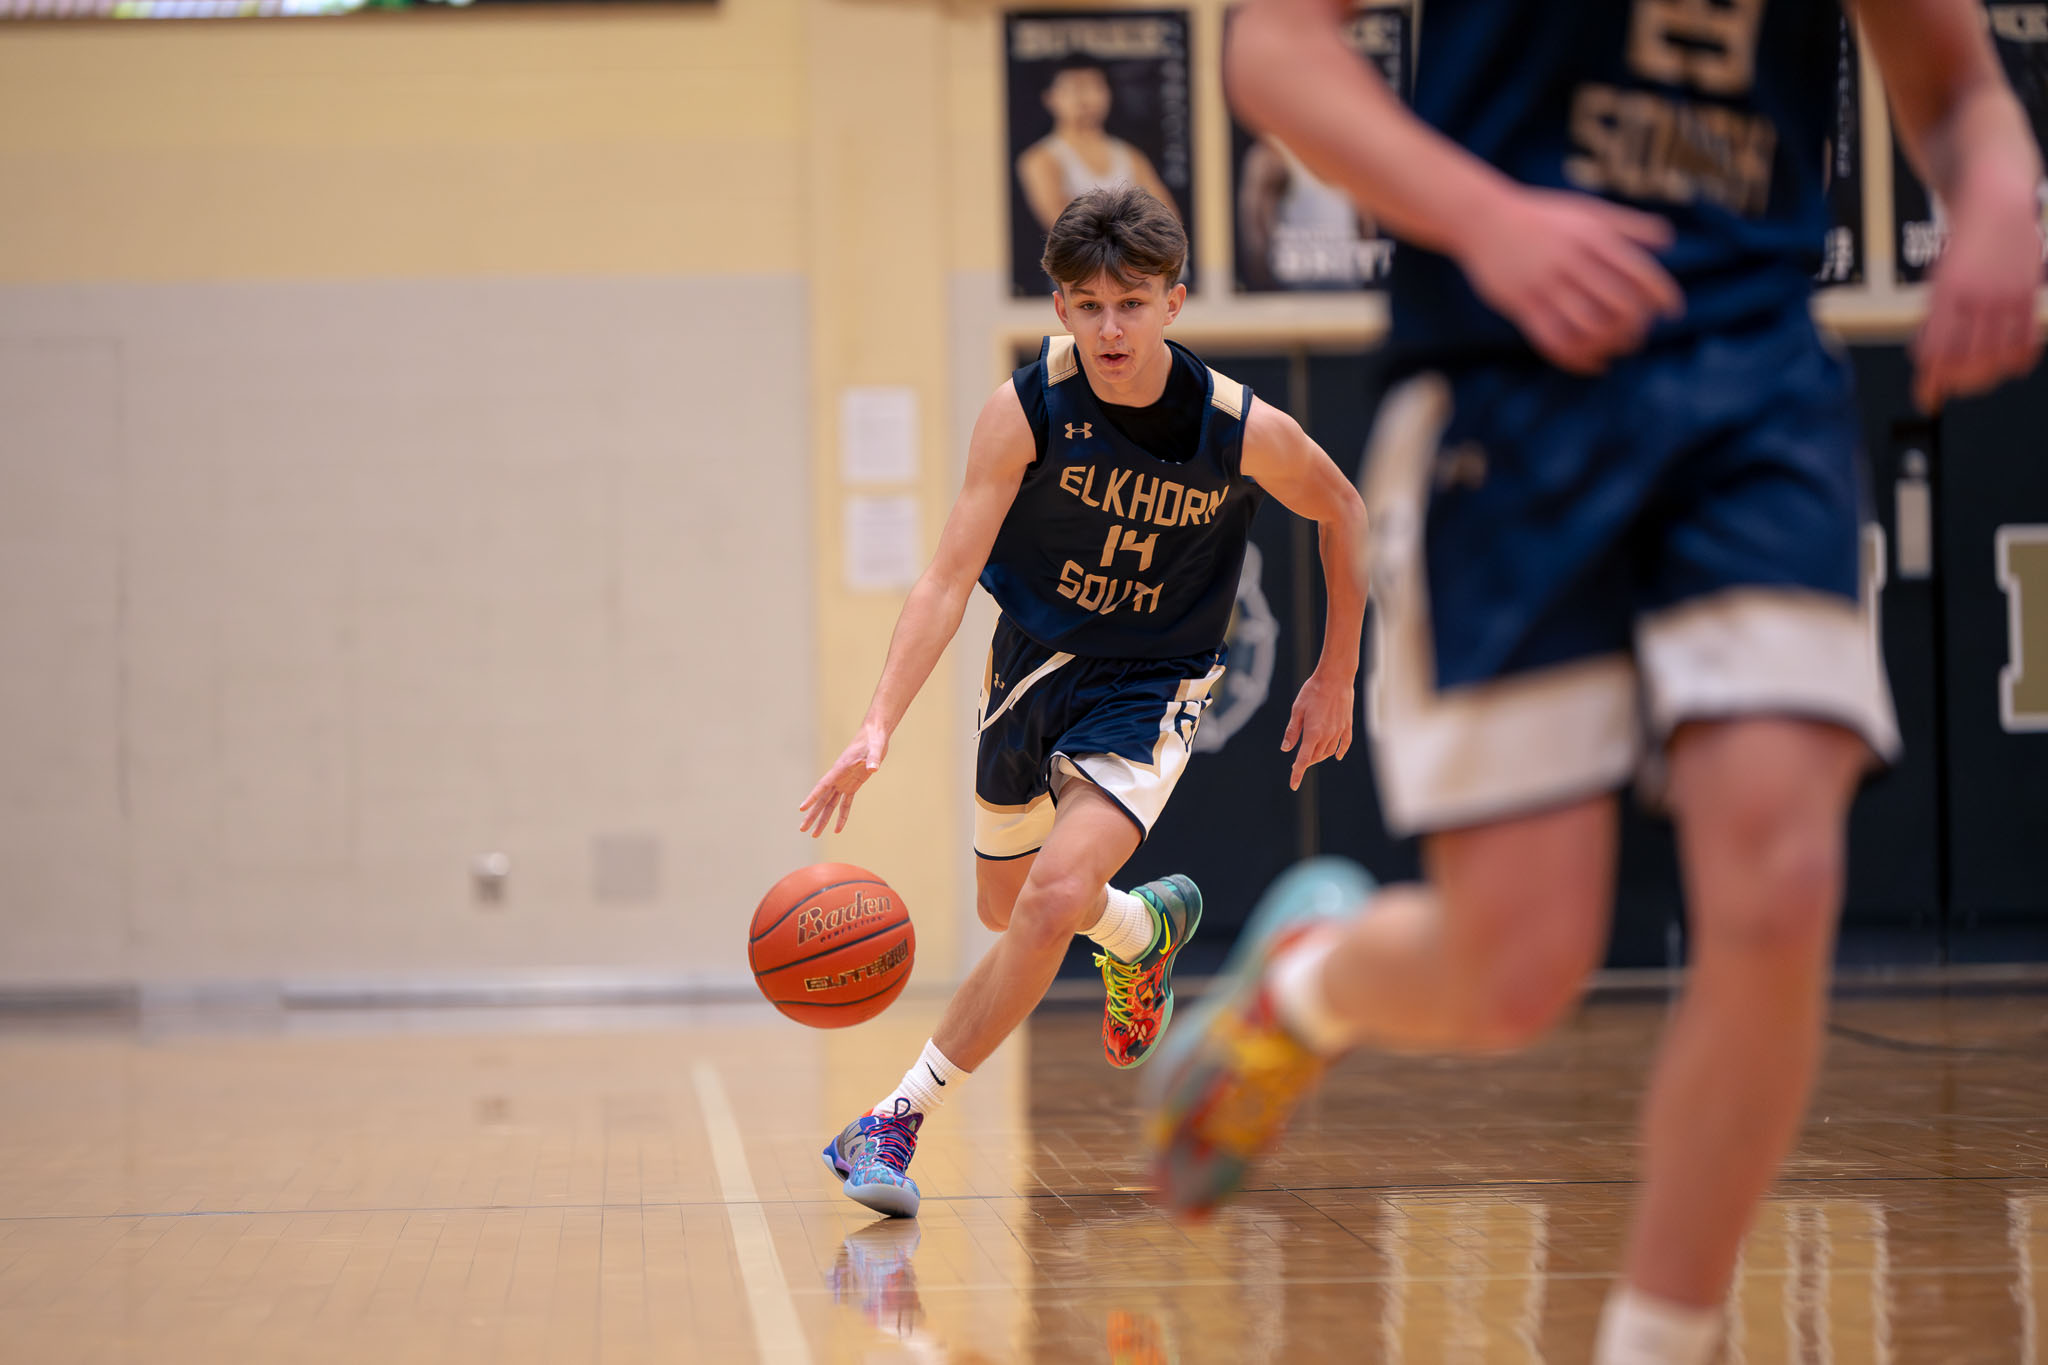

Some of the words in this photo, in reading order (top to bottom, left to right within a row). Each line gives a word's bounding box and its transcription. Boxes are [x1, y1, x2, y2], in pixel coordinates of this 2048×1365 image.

[1059, 464, 1230, 527] ELKHORN
[1099, 524, 1161, 572] 14
[797, 890, 892, 947] Baden
